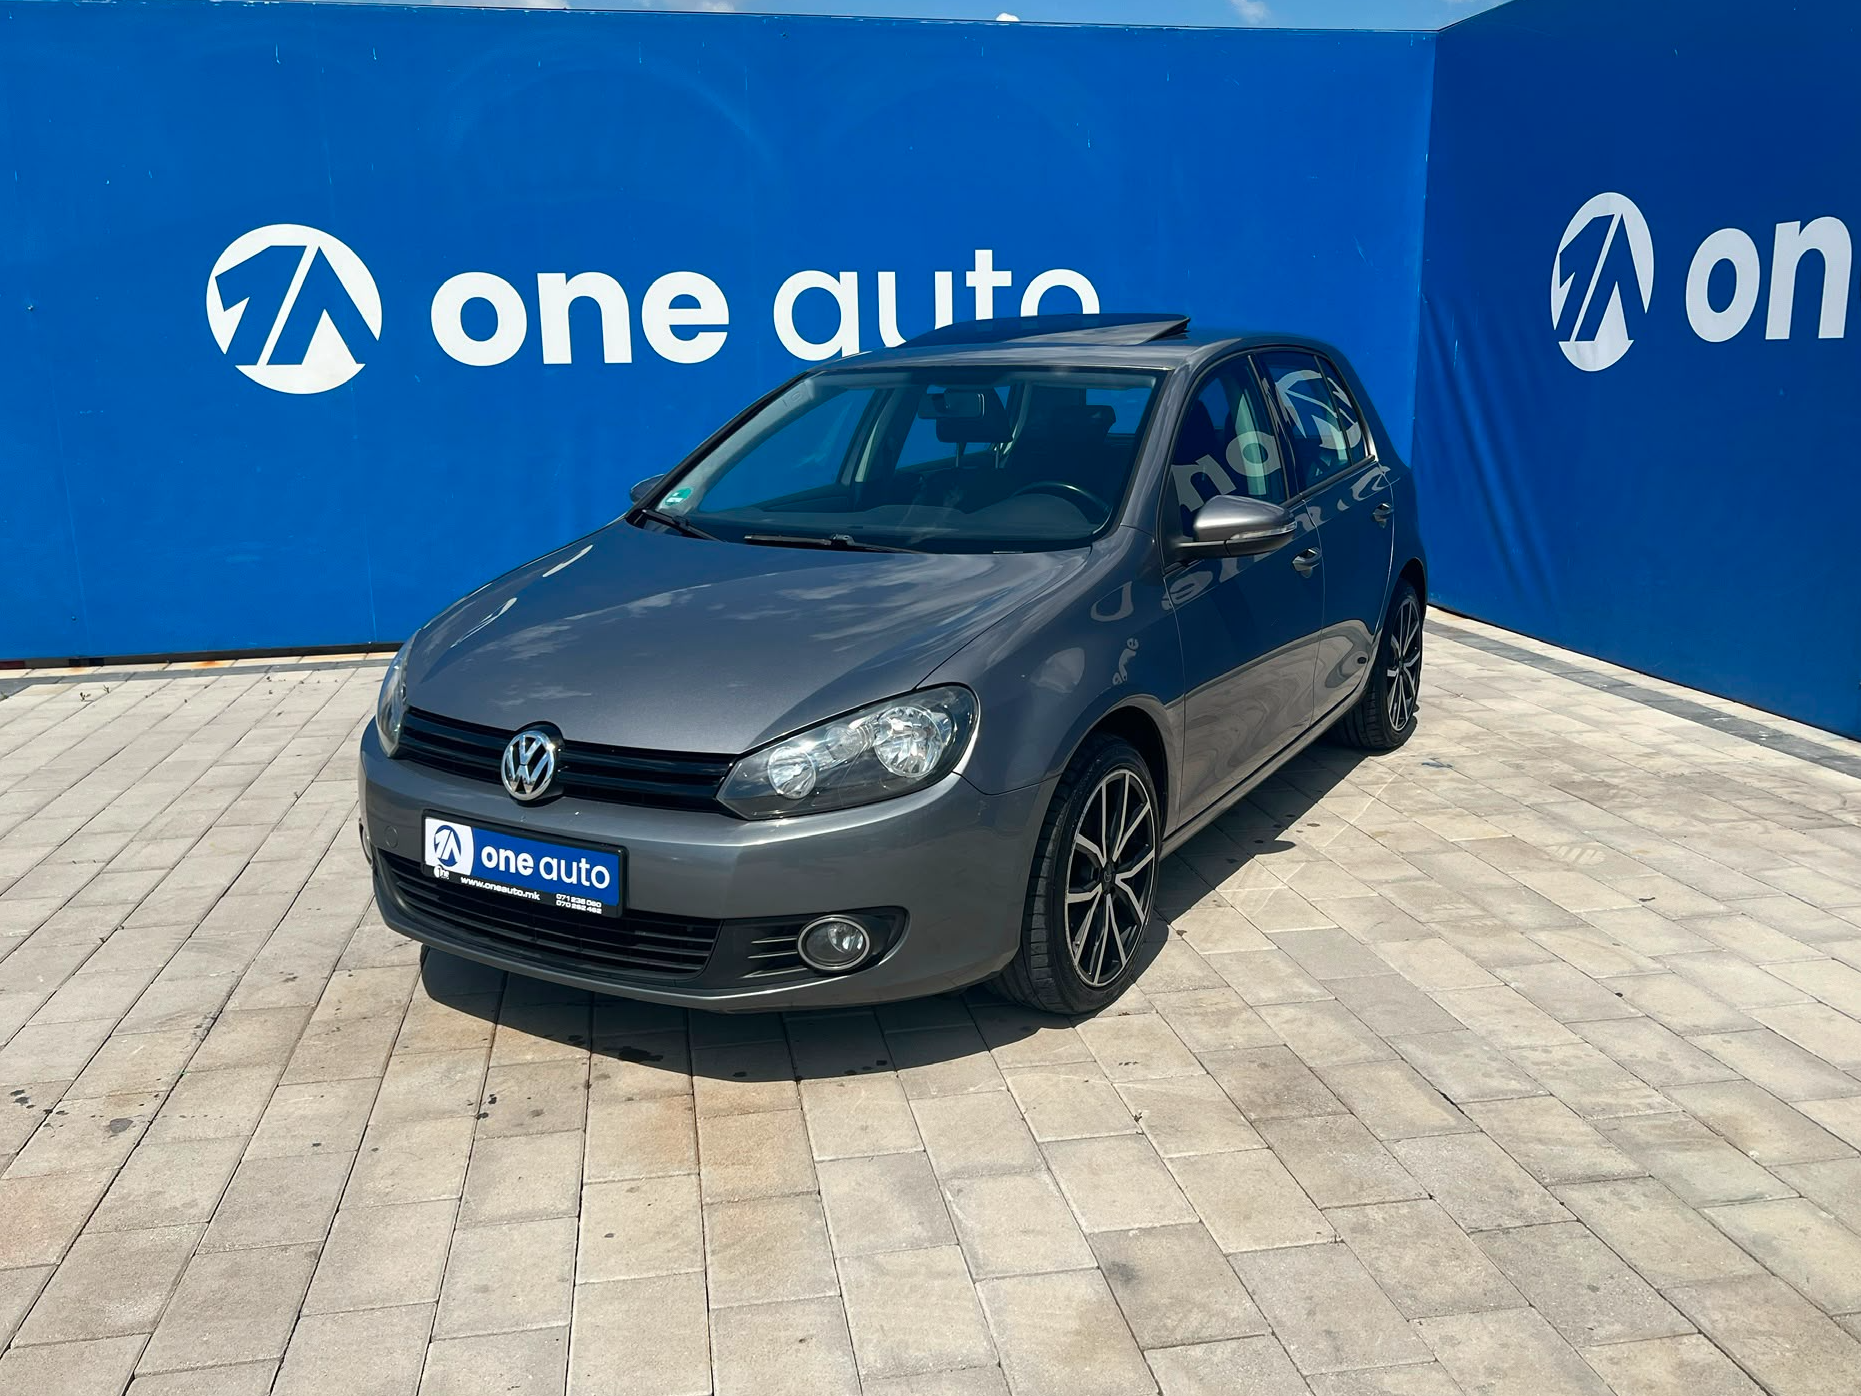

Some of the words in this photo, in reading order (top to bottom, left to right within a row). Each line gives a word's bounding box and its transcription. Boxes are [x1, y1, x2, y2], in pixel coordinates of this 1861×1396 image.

[430, 271, 730, 366] one
[481, 846, 534, 876] one
[539, 856, 610, 889] auto
[460, 876, 541, 901] www.oneauto.mk
[555, 899, 572, 908] 070
